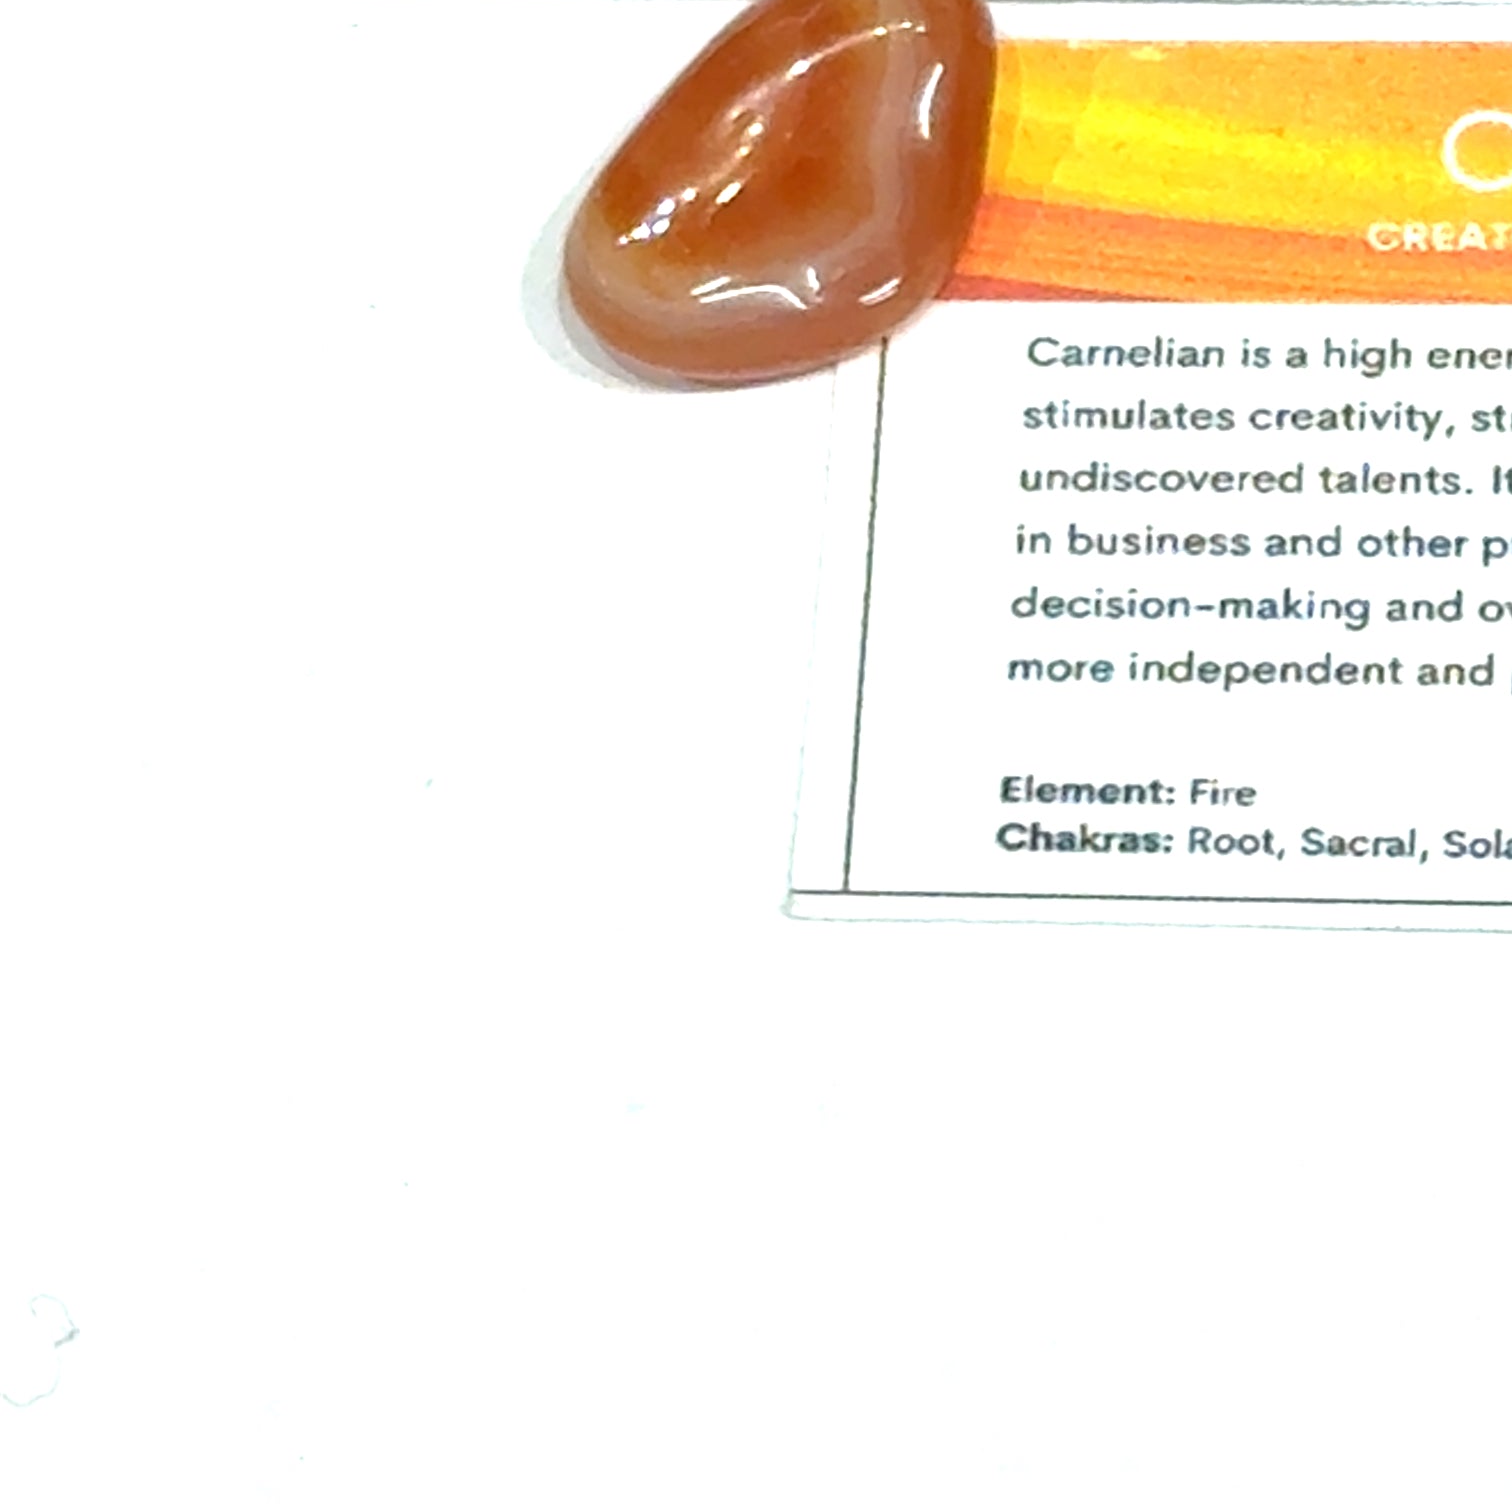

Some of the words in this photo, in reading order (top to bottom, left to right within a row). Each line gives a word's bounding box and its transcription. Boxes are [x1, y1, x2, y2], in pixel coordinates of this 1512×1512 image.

[1027, 335, 1225, 369] Carnelian
[1240, 337, 1272, 370] is
[1285, 346, 1309, 369] a
[1323, 336, 1413, 379] high
[1022, 398, 1236, 432] stimulates
[1248, 400, 1456, 442] creativity,
[1019, 460, 1305, 494] undiscovered
[1318, 462, 1474, 496] talents.
[1016, 523, 1052, 555] in
[1067, 522, 1252, 557] business
[1264, 524, 1342, 558] and
[1356, 524, 1470, 559] other
[1010, 585, 1371, 632] decision-making
[1385, 588, 1464, 623] and
[1007, 658, 1116, 684] more
[1128, 649, 1404, 693] independent
[1416, 652, 1495, 687] and
[999, 774, 1176, 806] Element:
[1189, 777, 1258, 808] Fire
[994, 821, 1175, 855] Chakras:
[1187, 825, 1286, 862] Root,
[1300, 826, 1429, 865] Sacral,
